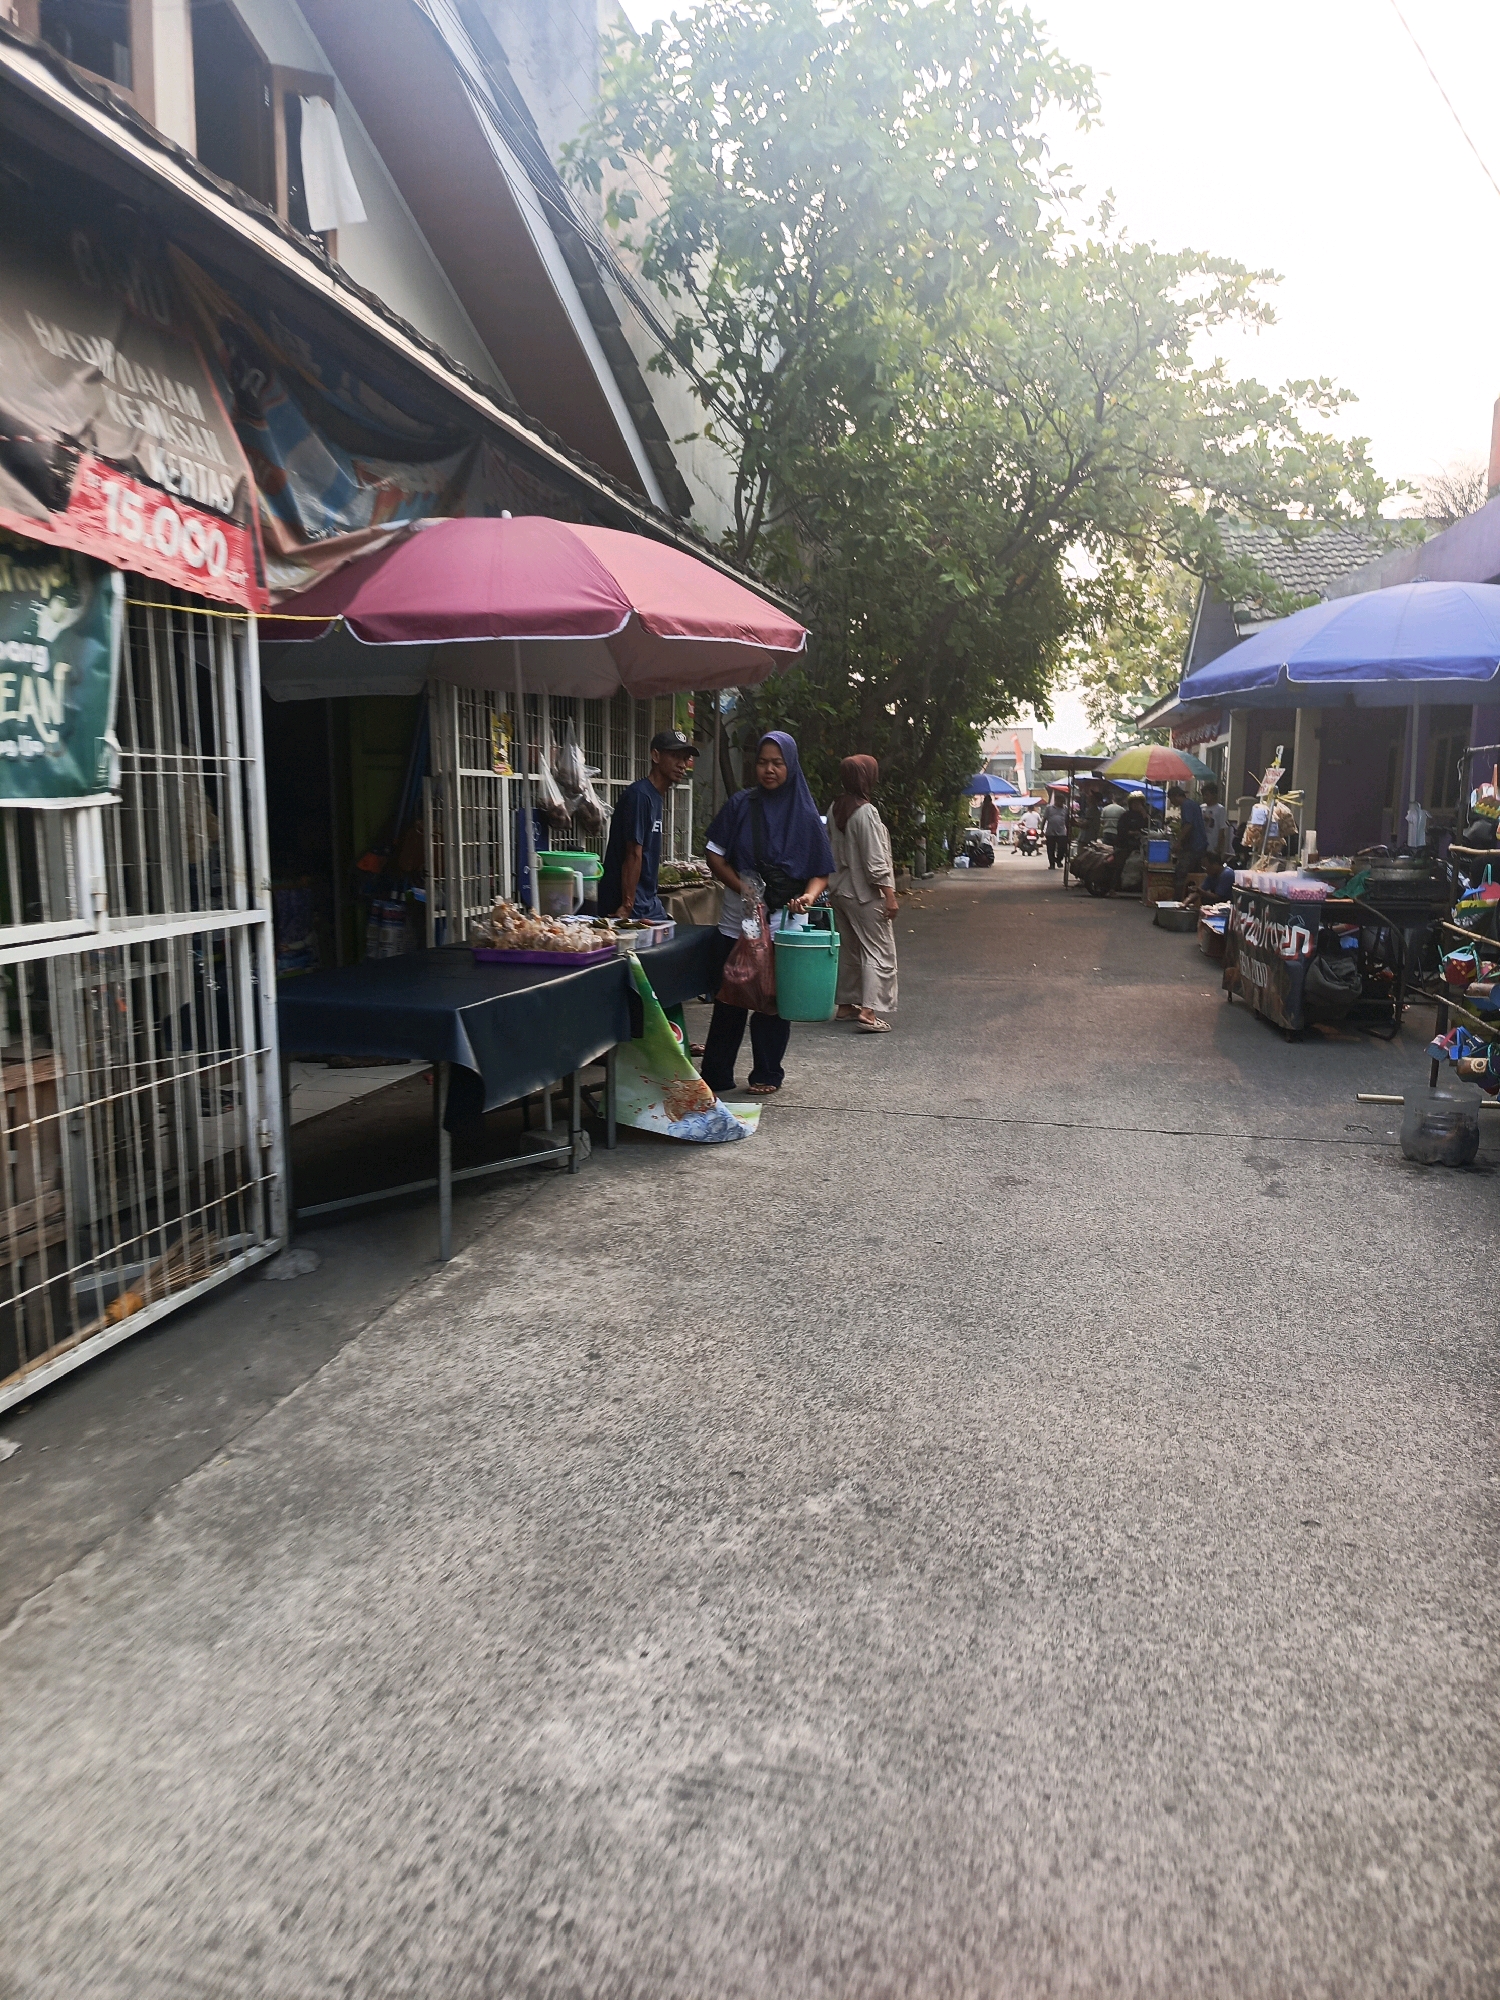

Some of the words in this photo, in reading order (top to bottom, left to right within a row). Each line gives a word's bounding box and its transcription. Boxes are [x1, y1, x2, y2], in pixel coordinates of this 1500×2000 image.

[100, 383, 228, 466] KEMASAN
[115, 350, 207, 423] DALAM
[102, 479, 229, 578] 15.000
